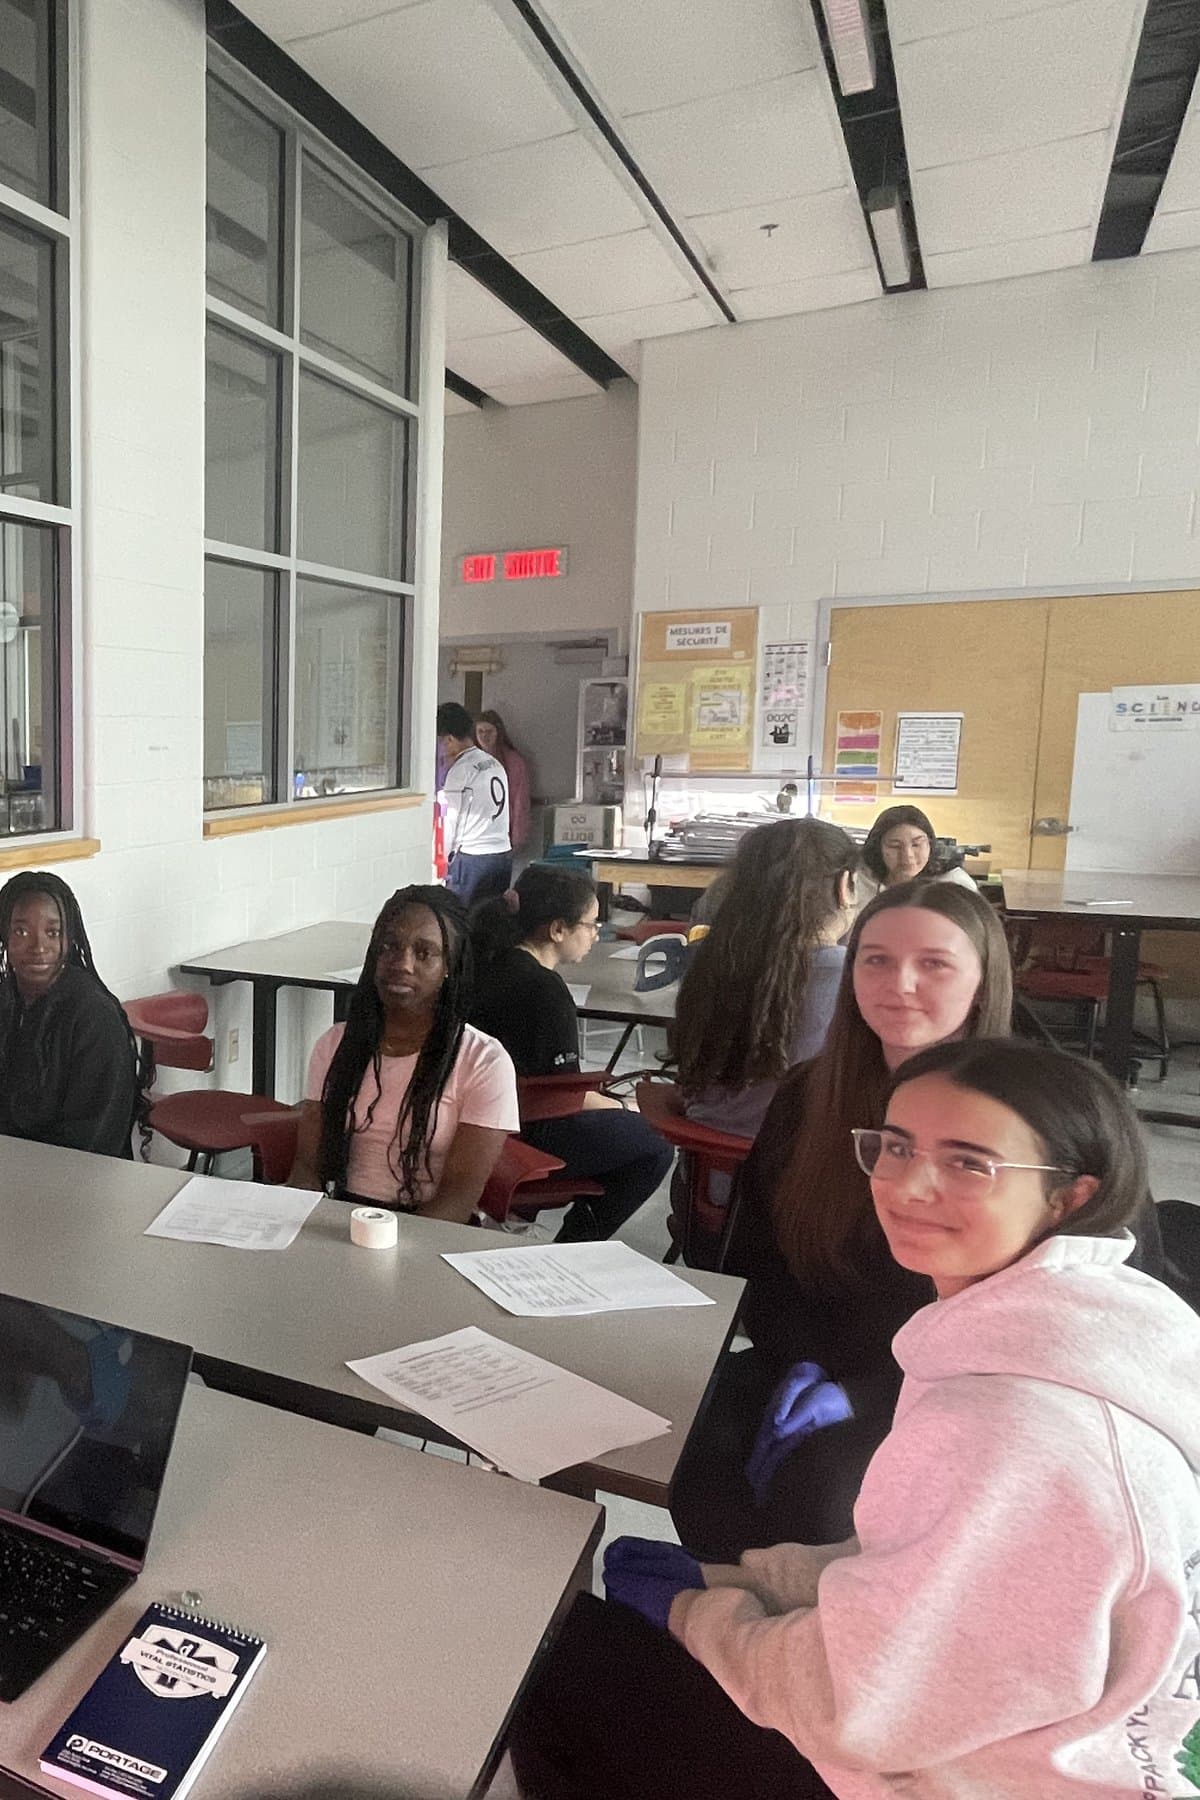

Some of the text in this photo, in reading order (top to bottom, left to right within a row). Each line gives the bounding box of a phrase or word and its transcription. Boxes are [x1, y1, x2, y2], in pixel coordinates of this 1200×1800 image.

[669, 625, 728, 636] MESURES DE
[490, 776, 506, 822] 9
[140, 1650, 164, 1665] VITAL
[165, 1661, 217, 1684] STATISTICS
[88, 1744, 162, 1780] PORTAGE
